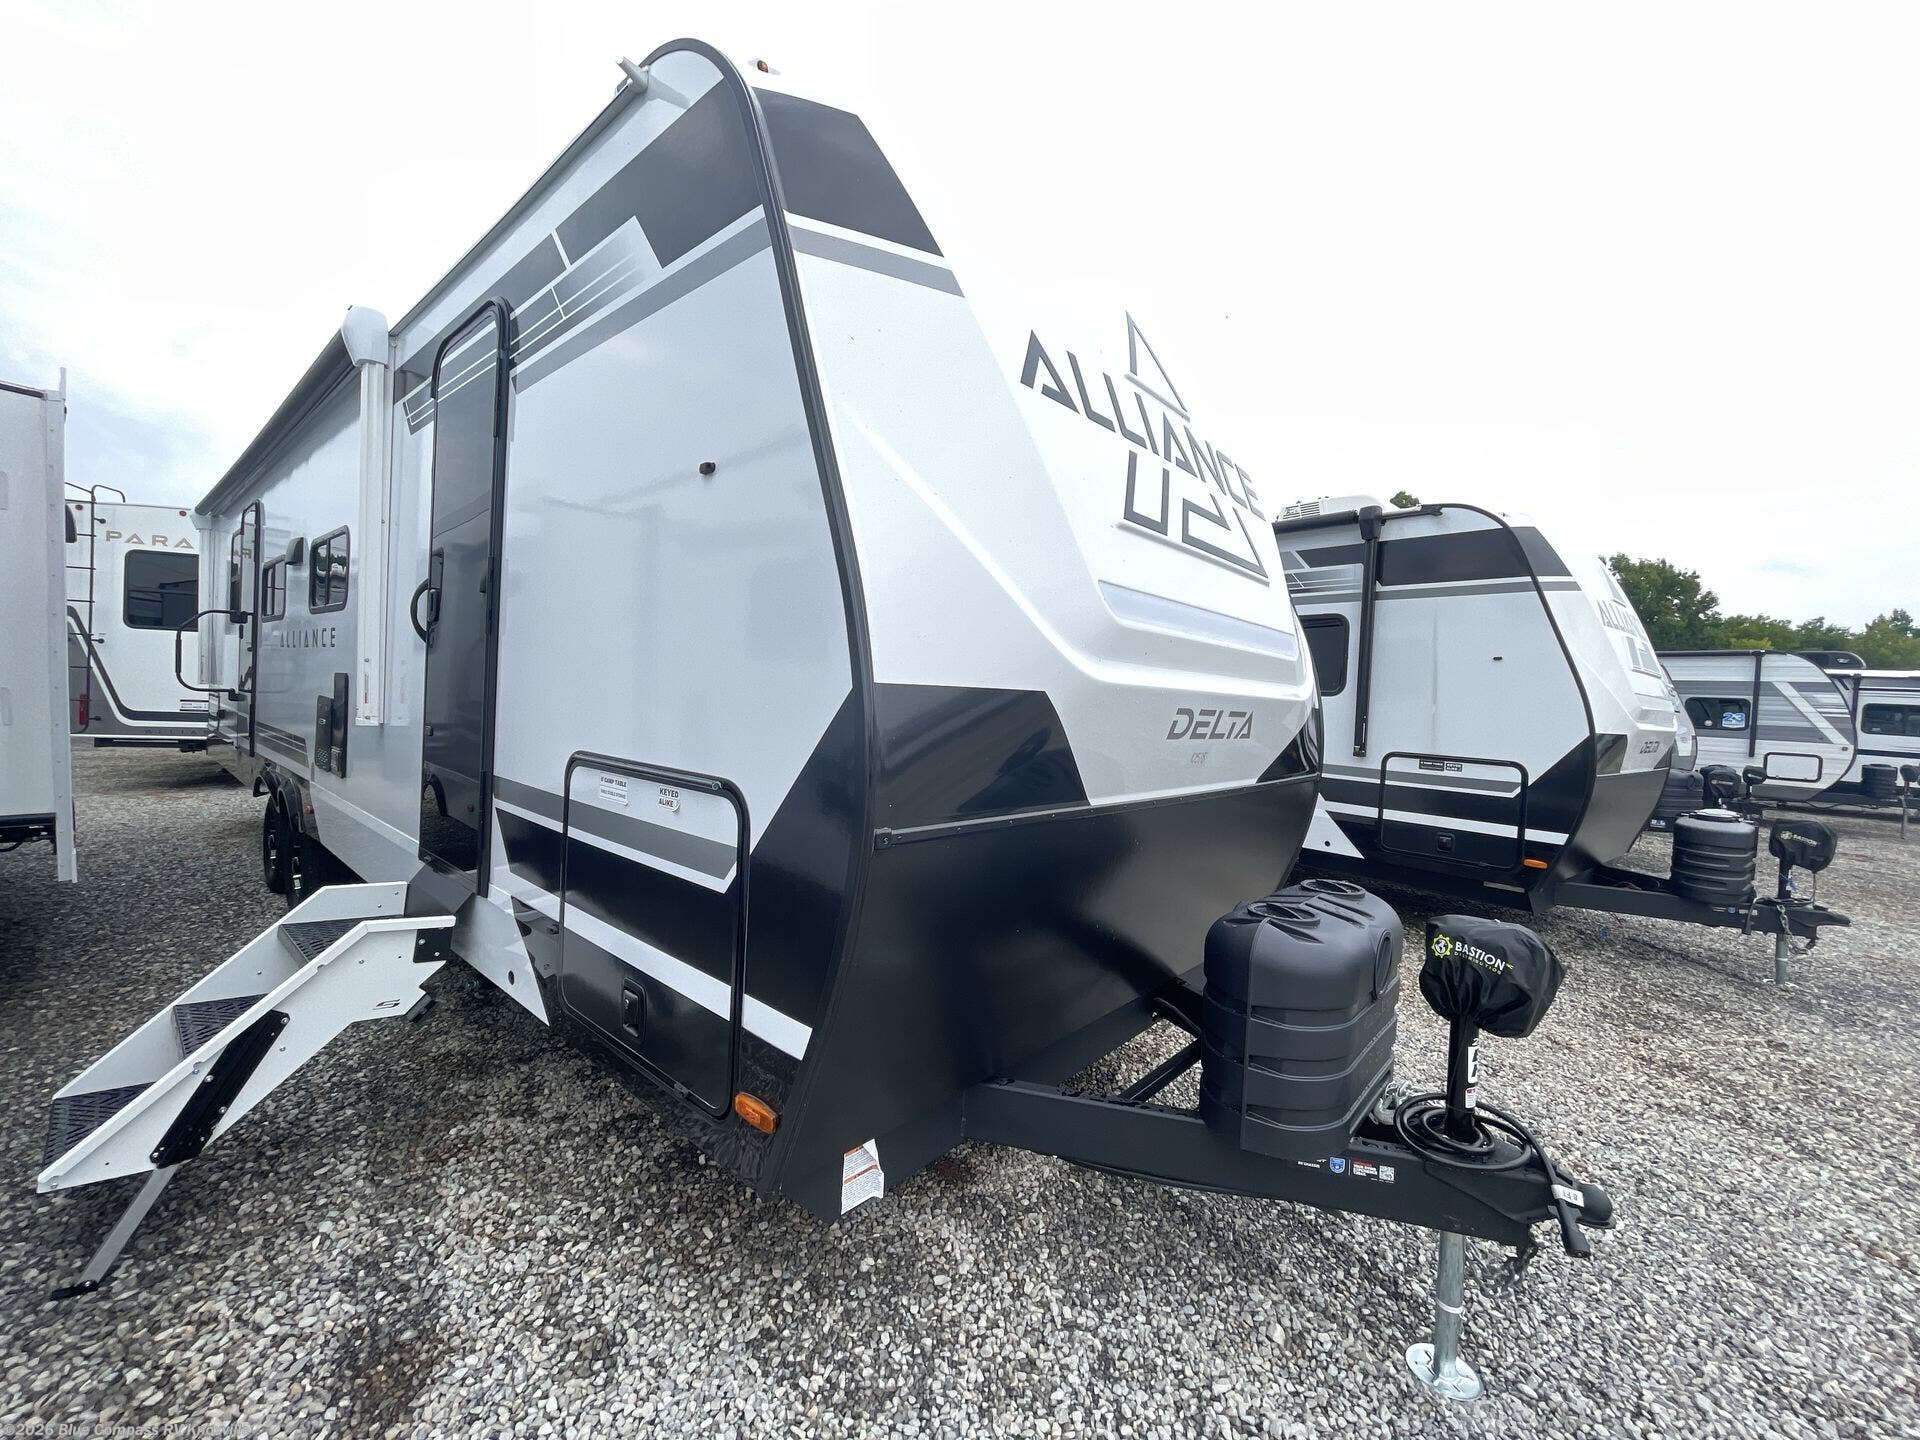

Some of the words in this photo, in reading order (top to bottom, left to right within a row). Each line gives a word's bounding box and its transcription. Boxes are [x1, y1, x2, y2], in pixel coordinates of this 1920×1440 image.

[1020, 329, 1267, 522] ALLIANCE
[105, 530, 194, 549] PARA
[280, 627, 336, 648] ALLIANCE
[1166, 707, 1254, 740] DELTA
[659, 787, 679, 799] KEYED
[659, 797, 674, 808] ALIKE
[1455, 941, 1506, 971] BASTION
